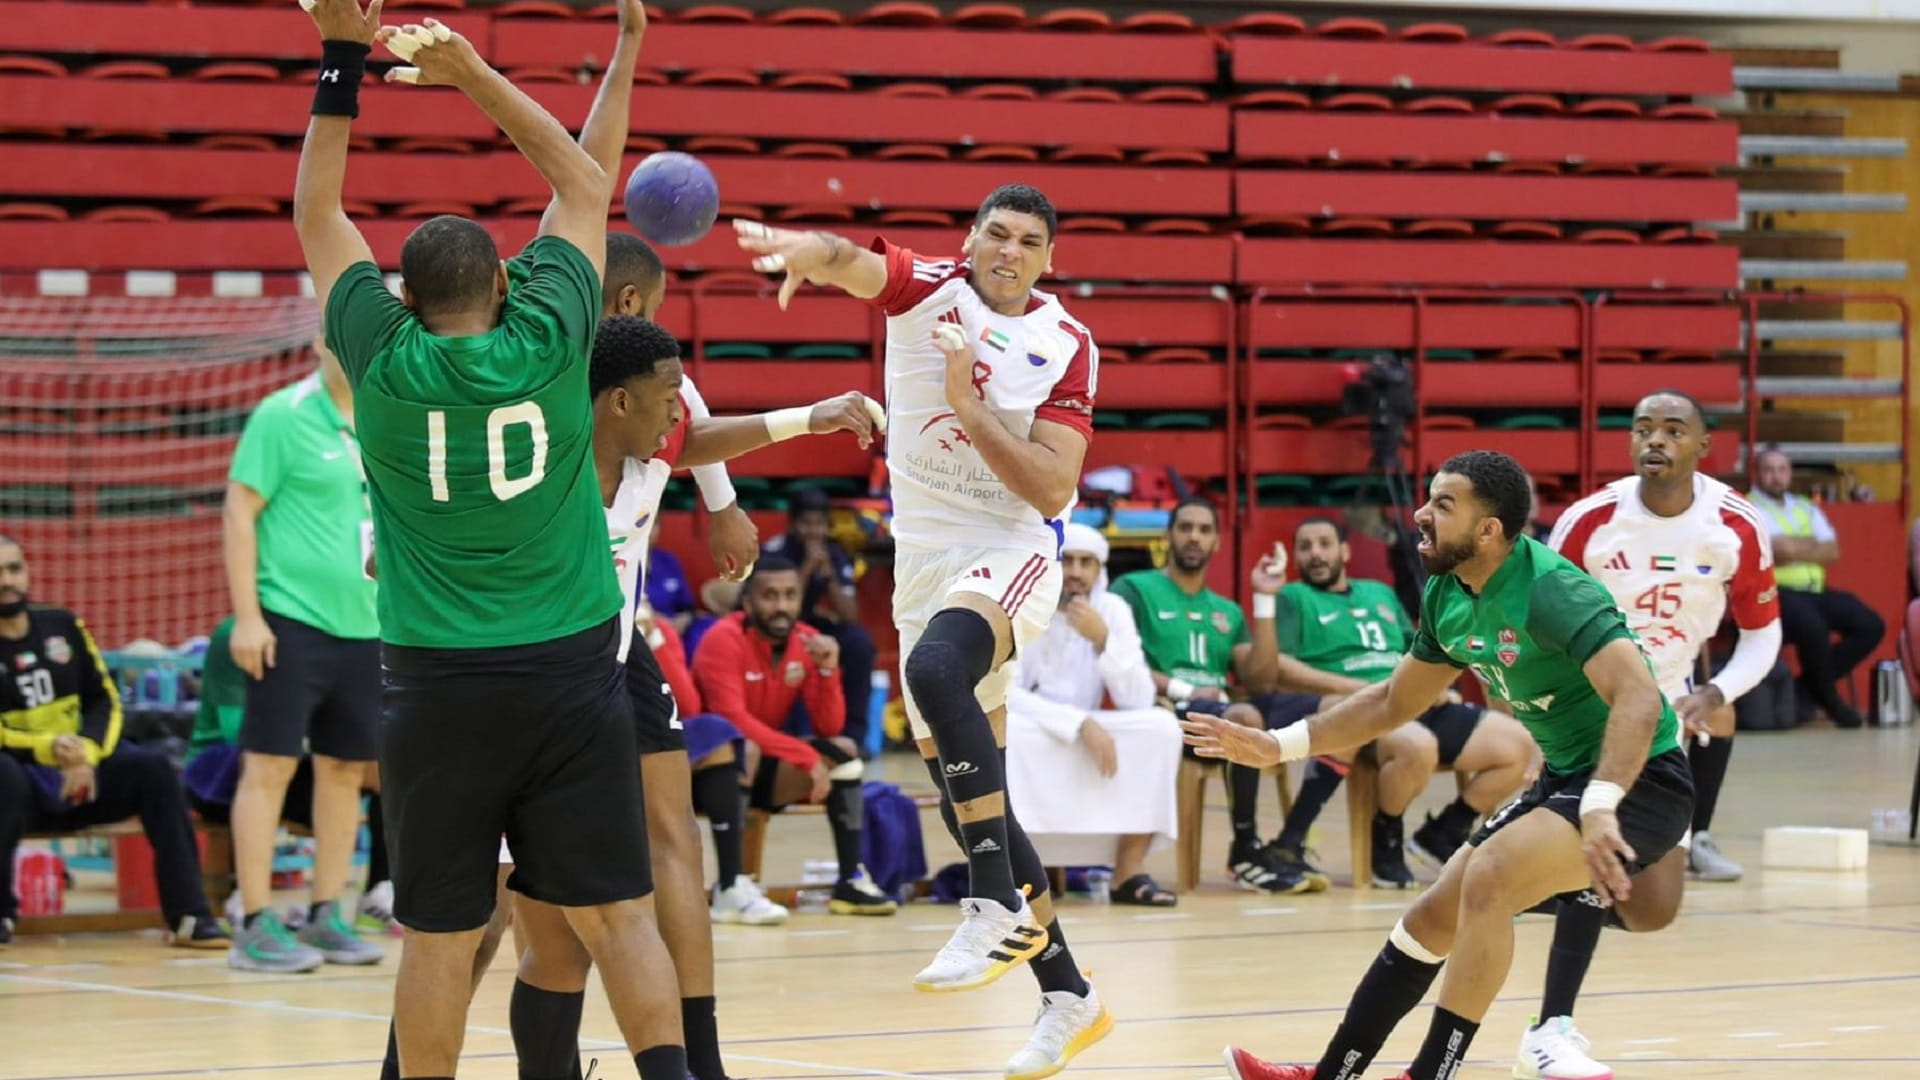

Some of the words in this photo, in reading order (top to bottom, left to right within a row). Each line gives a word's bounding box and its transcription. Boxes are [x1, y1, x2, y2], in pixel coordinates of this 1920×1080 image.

[428, 401, 549, 502] 10
[905, 449, 962, 477] الشارقة
[906, 465, 950, 492] Sharjah
[952, 482, 1005, 500] Airport
[966, 466, 1004, 483] طار
[1635, 582, 1683, 619] 45
[1189, 629, 1207, 666] 11
[1355, 620, 1387, 651] 13
[16, 668, 55, 708] 50
